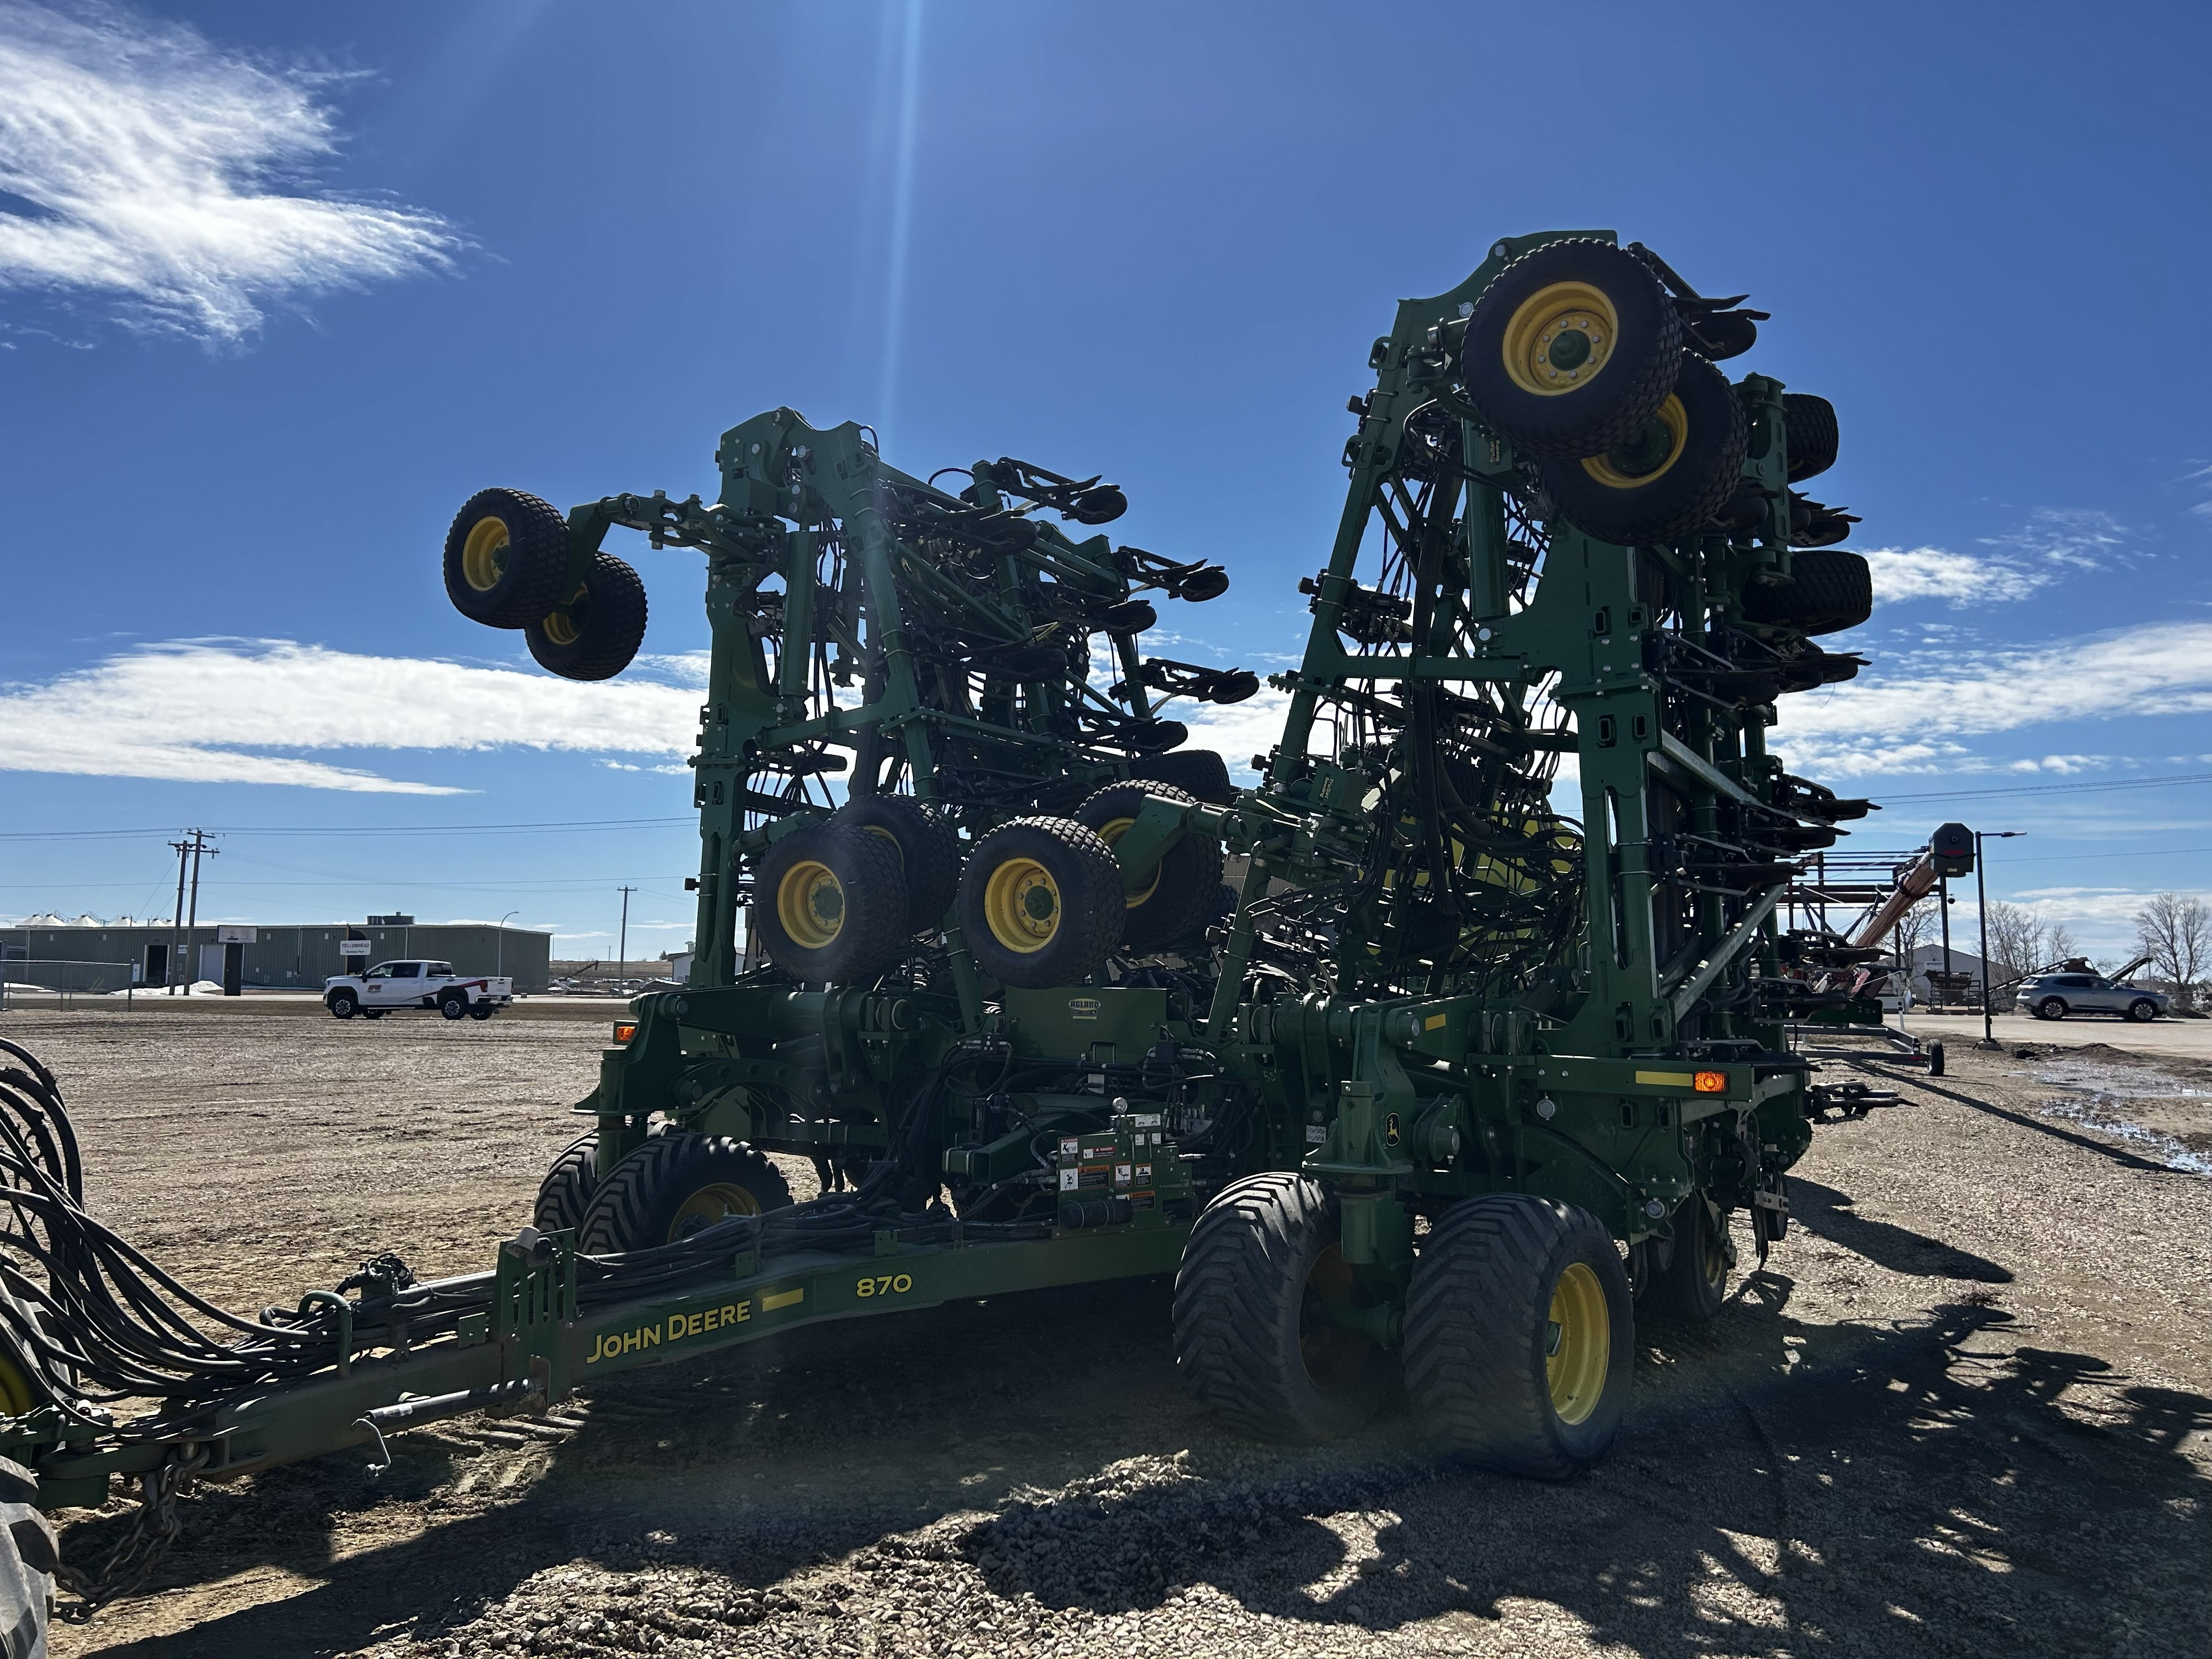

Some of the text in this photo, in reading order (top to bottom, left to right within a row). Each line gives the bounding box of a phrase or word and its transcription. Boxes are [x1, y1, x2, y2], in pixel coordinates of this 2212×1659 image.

[1325, 778, 1334, 799] TruSet
[856, 1273, 913, 1298] 870
[585, 1299, 752, 1364] JOHN DEERE
